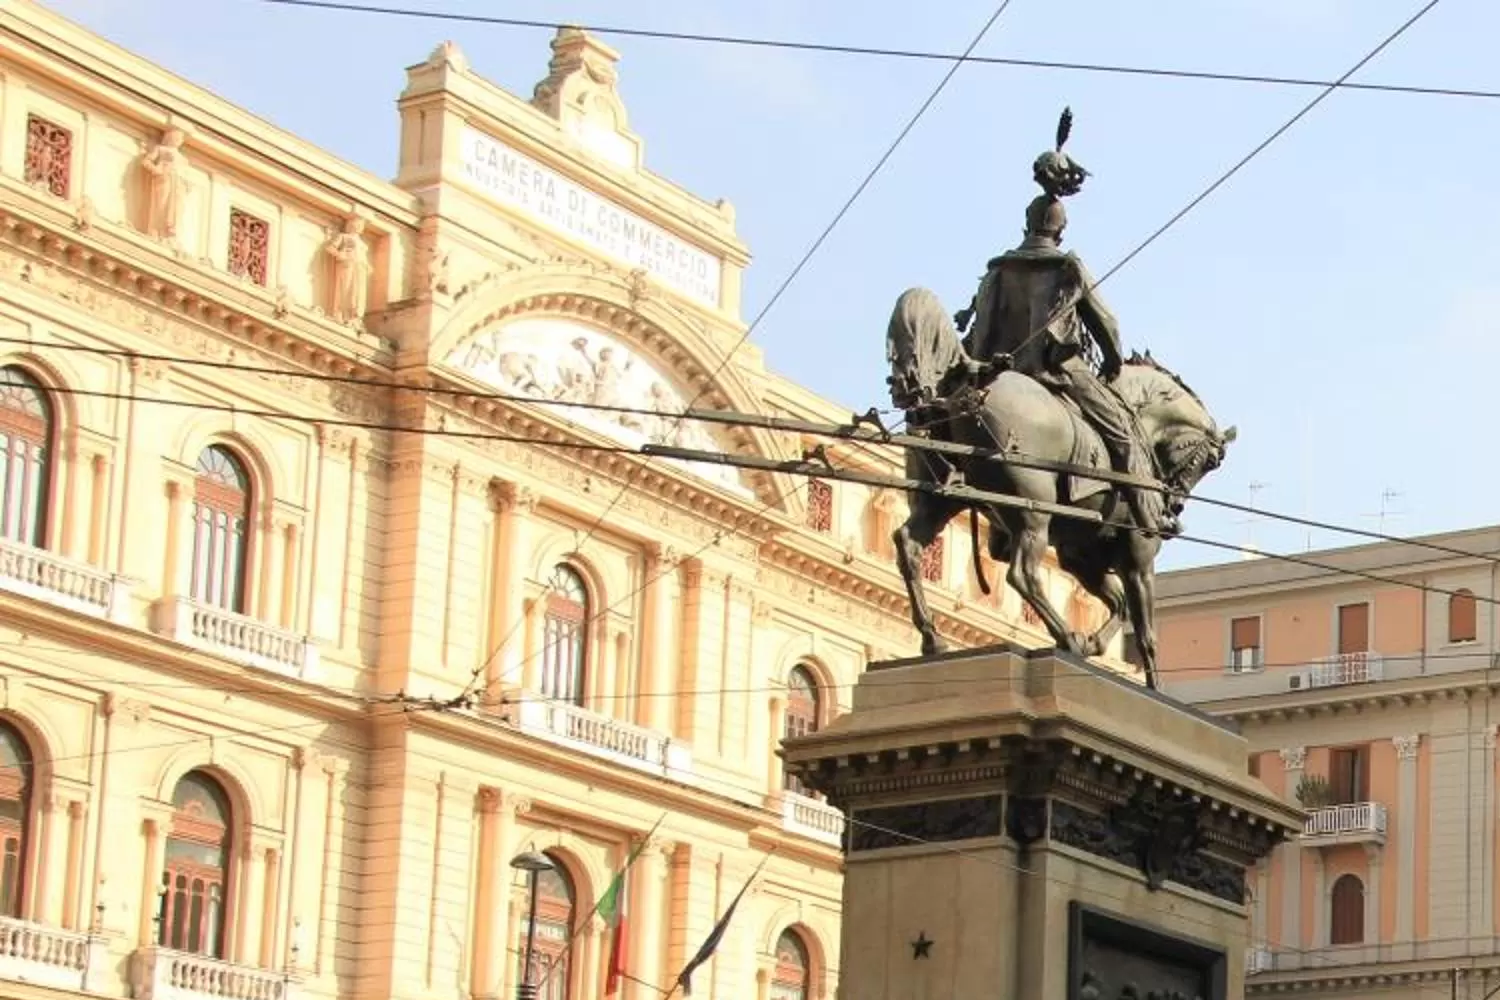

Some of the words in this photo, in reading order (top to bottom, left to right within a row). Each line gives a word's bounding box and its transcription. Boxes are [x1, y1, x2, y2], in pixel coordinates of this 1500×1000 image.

[473, 139, 556, 203] CAMERA
[568, 189, 587, 217] DI
[597, 204, 707, 280] COMMERCIO
